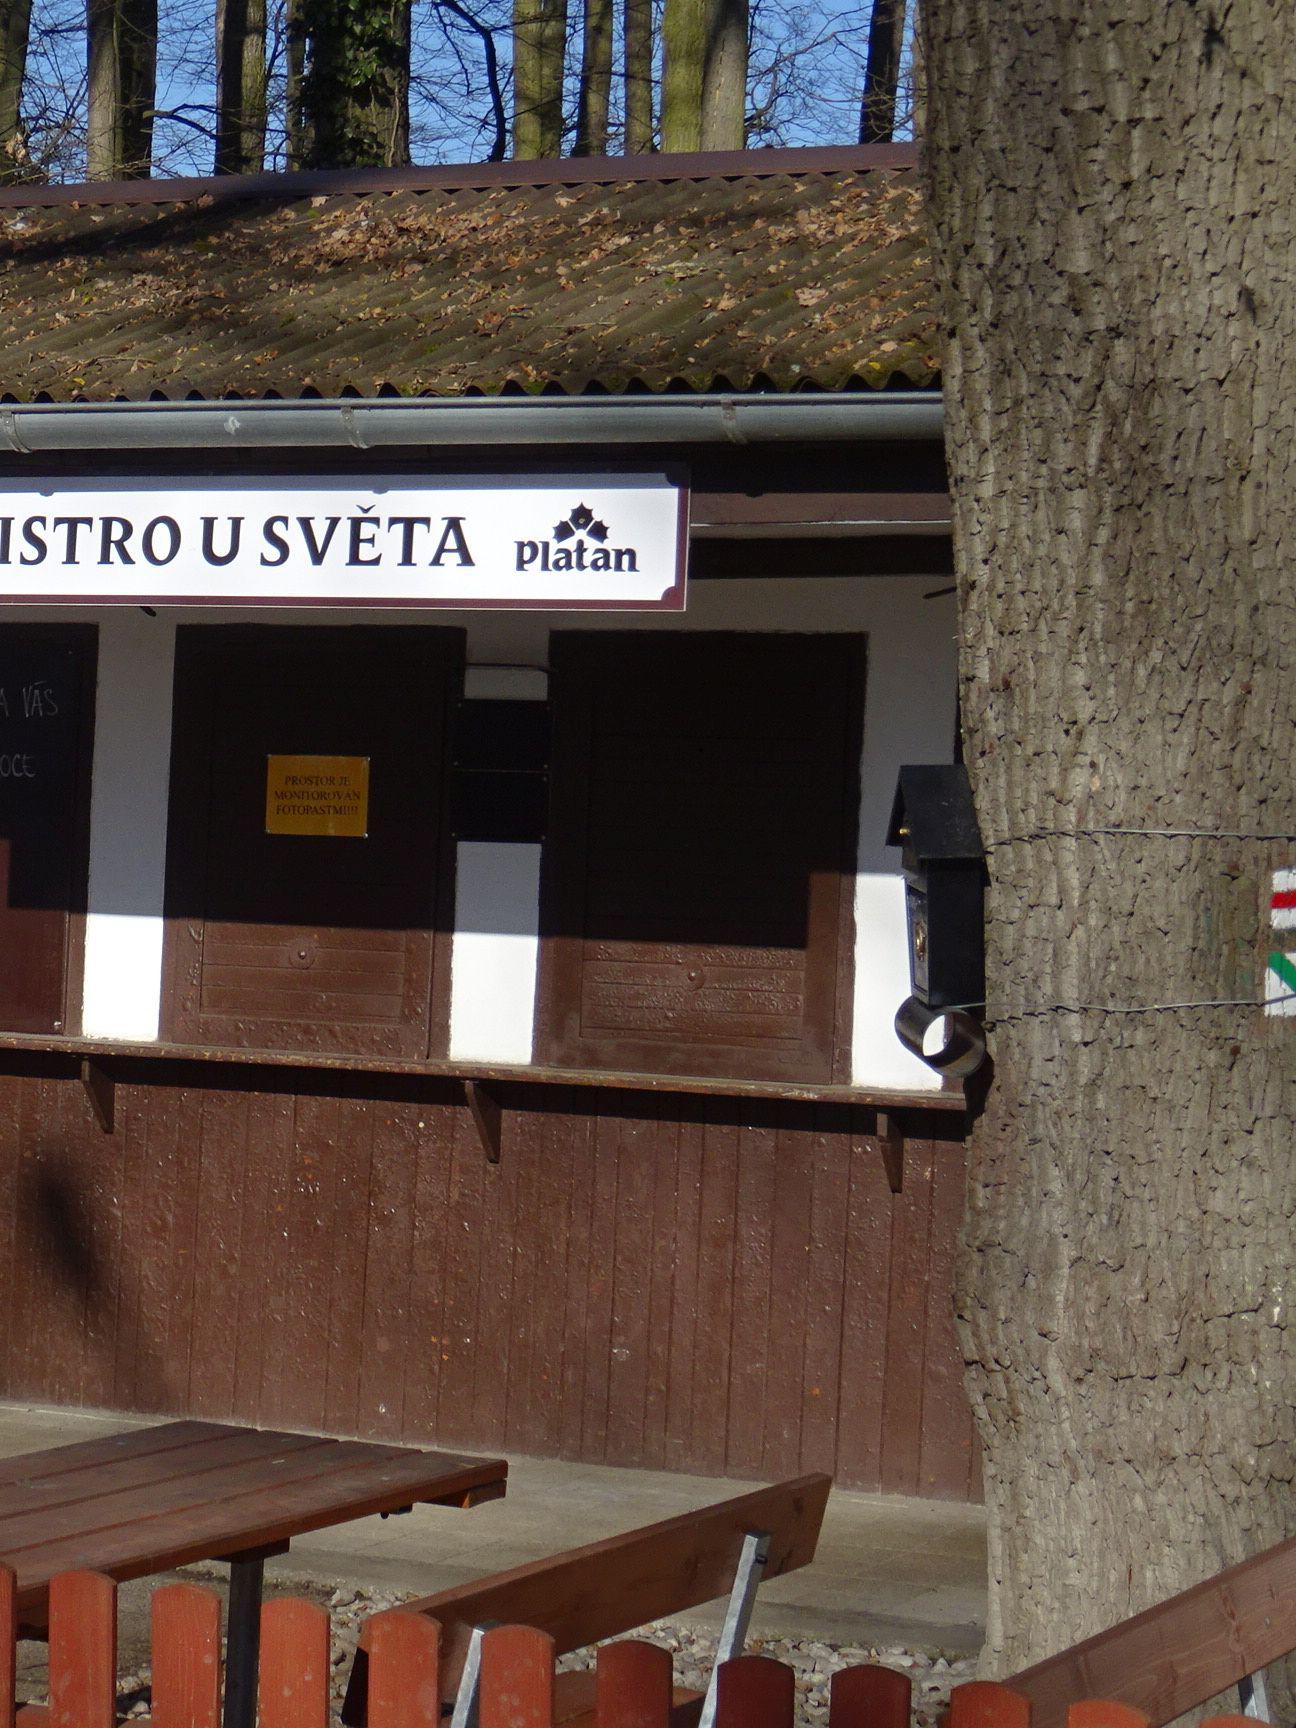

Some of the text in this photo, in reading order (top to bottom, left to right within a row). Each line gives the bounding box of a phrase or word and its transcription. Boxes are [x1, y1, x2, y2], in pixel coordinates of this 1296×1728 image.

[200, 515, 245, 567] U
[260, 504, 476, 567] SVĚTA
[22, 680, 59, 718] VÁS
[284, 775, 350, 786] PROSTOR JE
